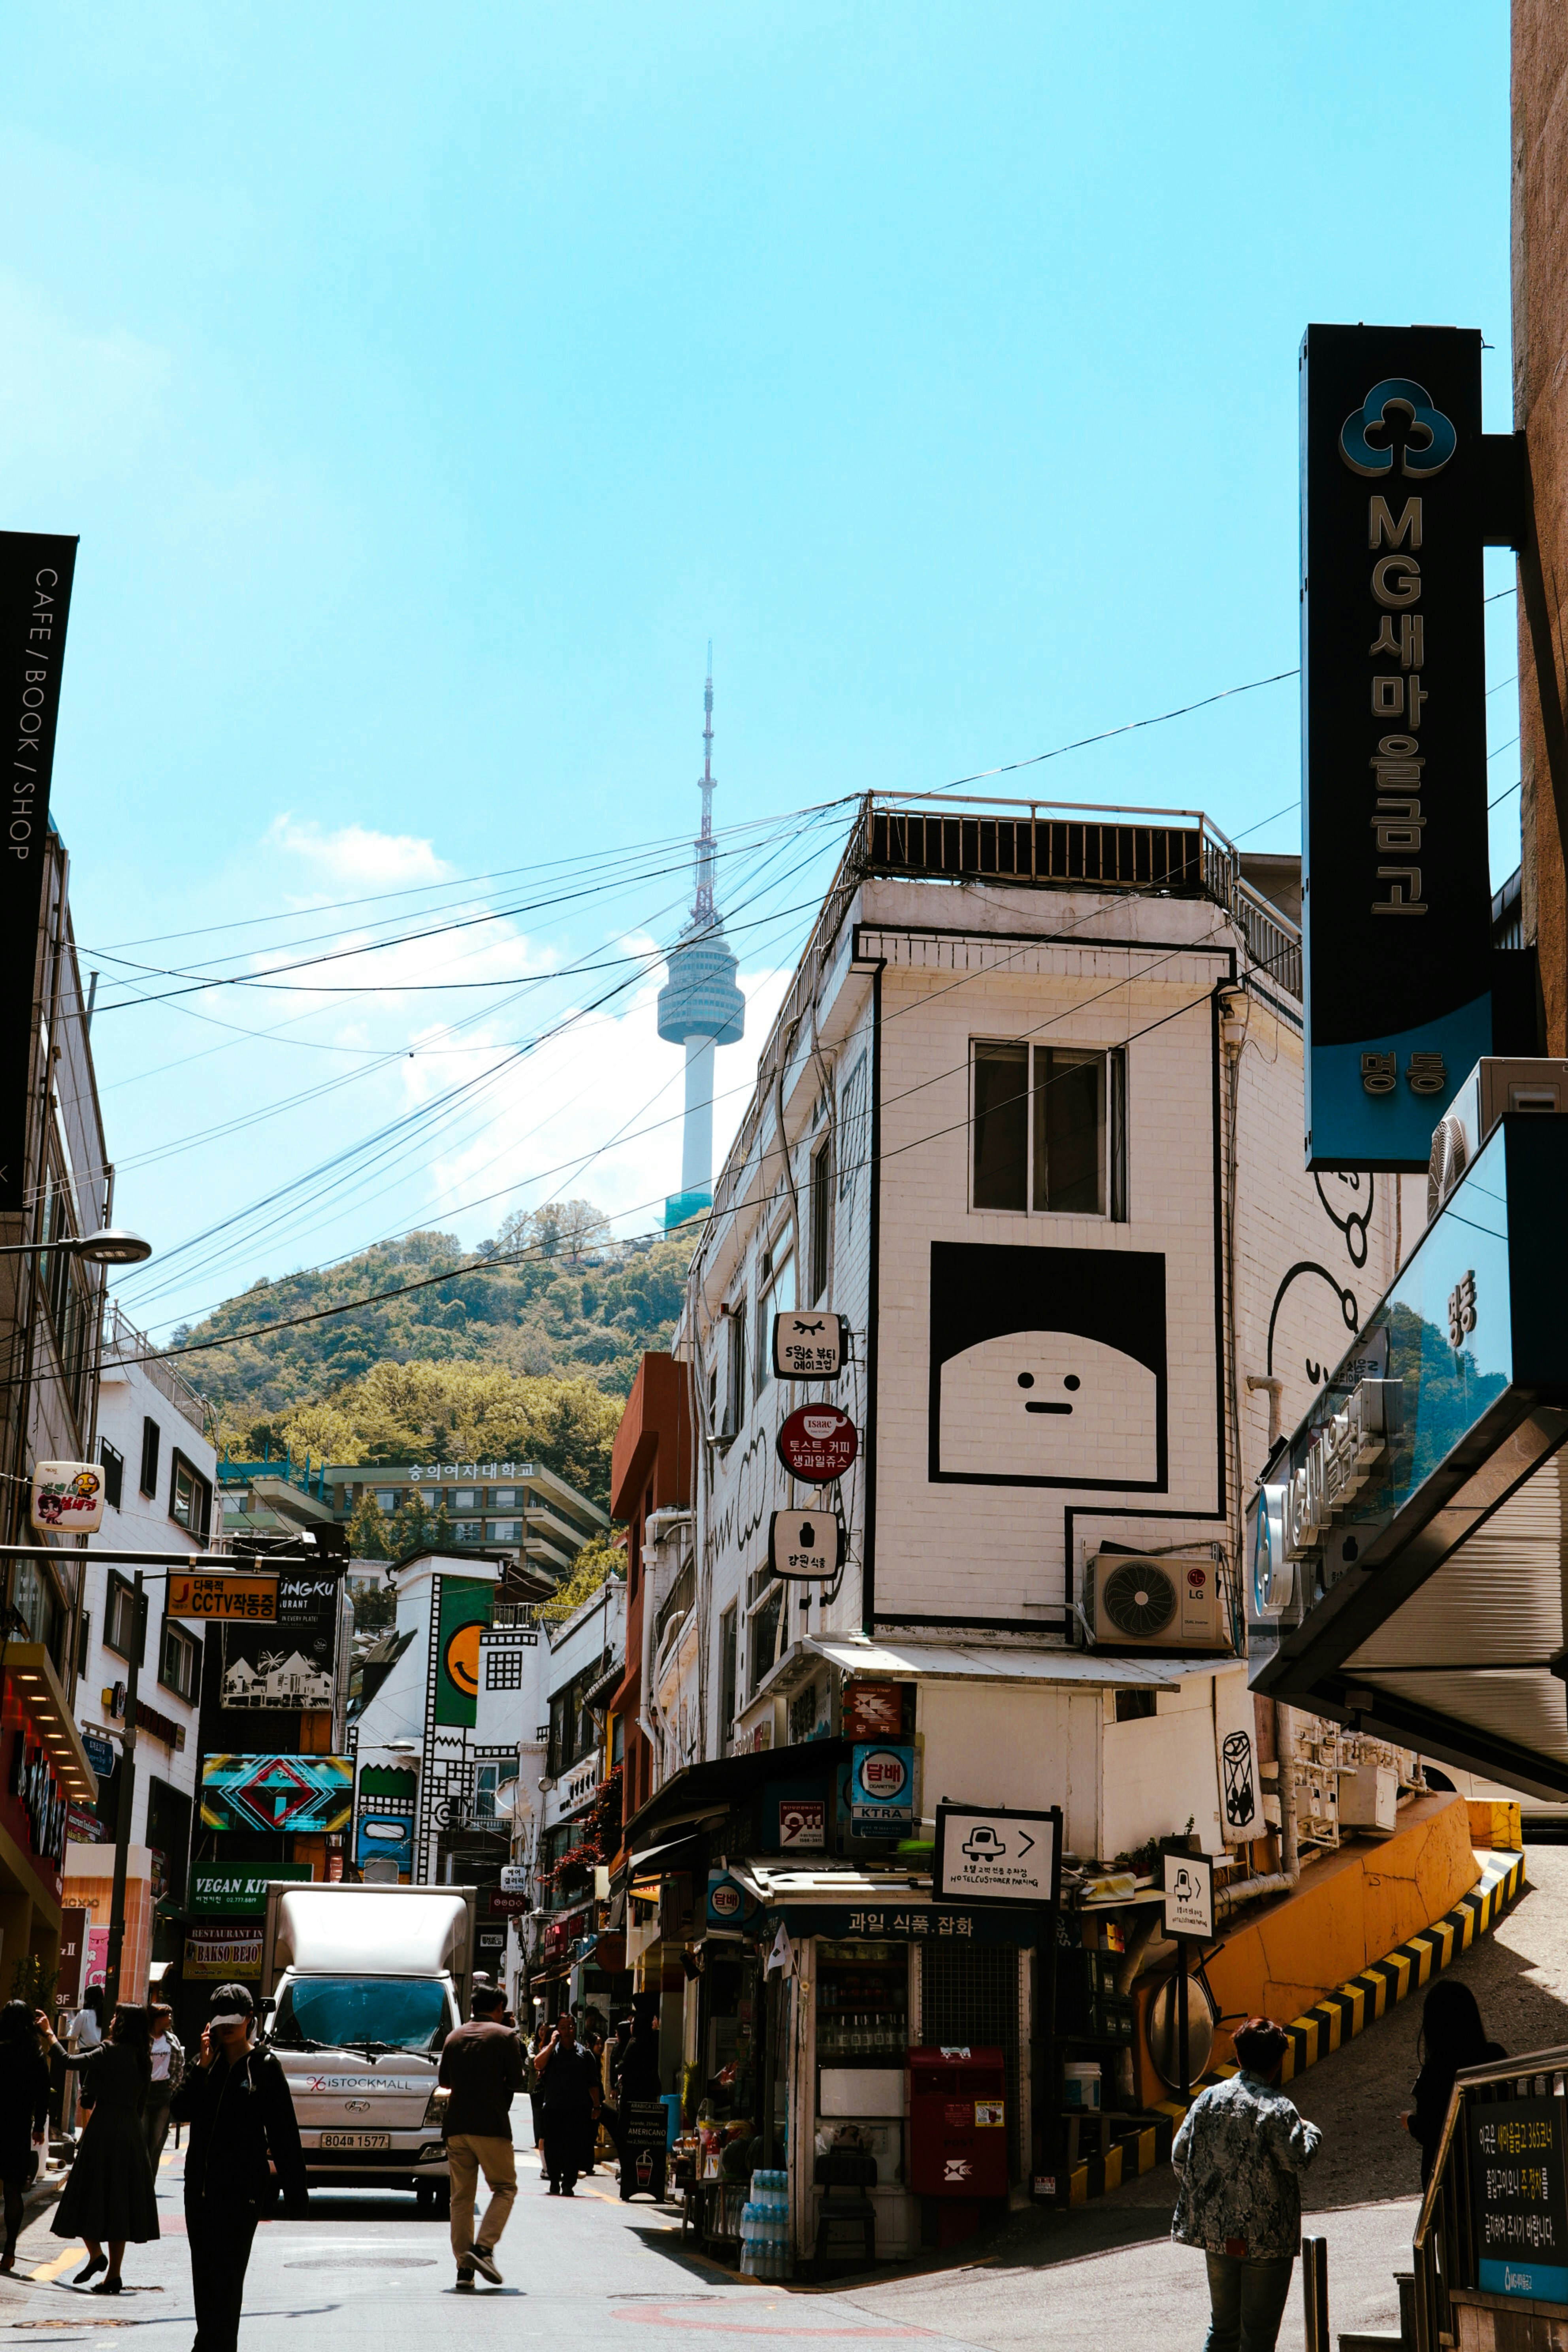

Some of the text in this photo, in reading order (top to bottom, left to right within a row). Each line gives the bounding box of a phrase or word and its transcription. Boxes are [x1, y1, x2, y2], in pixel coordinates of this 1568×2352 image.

[30, 568, 58, 640] CAFE
[17, 670, 46, 752] BOOK
[1369, 495, 1428, 915] MG새마을금고
[8, 782, 35, 860] SHOP
[1359, 1049, 1447, 1095] 명동
[1448, 1269, 1477, 1347] 명동
[817, 1347, 836, 1361] 뷰티
[793, 1359, 832, 1371] 메이크업
[790, 1440, 850, 1454] 토스트, 커피
[793, 1455, 847, 1468] 생과일쥬스
[408, 1462, 535, 1481] 숭의여자대학교
[788, 1555, 825, 1568] 강원 식품
[193, 1580, 224, 1592] 다목적
[281, 1580, 335, 1596] UNGKU
[1189, 1590, 1204, 1599] LG
[192, 1592, 274, 1617] CCTV작동중
[280, 1600, 308, 1608] URANT
[867, 1764, 901, 1783] 담배
[862, 1808, 902, 1819] KTRA
[196, 1879, 242, 1893] VEGAN
[715, 1893, 738, 1907] 담배
[192, 1930, 251, 1938] RESTAURANT
[197, 1946, 258, 1963] BAKSO BEJO
[56, 1994, 70, 2005] 3F
[328, 2078, 412, 2090] iSTOCKMALL
[628, 2128, 666, 2136] AMERICANO
[1479, 2120, 1552, 2154] 이곳은 새마을금고 365코너
[325, 2136, 385, 2147] 804마 1577
[1487, 2167, 1548, 2200] 출입구이오니 주.정차를
[1485, 2213, 1555, 2247] 금지하여 주시기 바랍니다.
